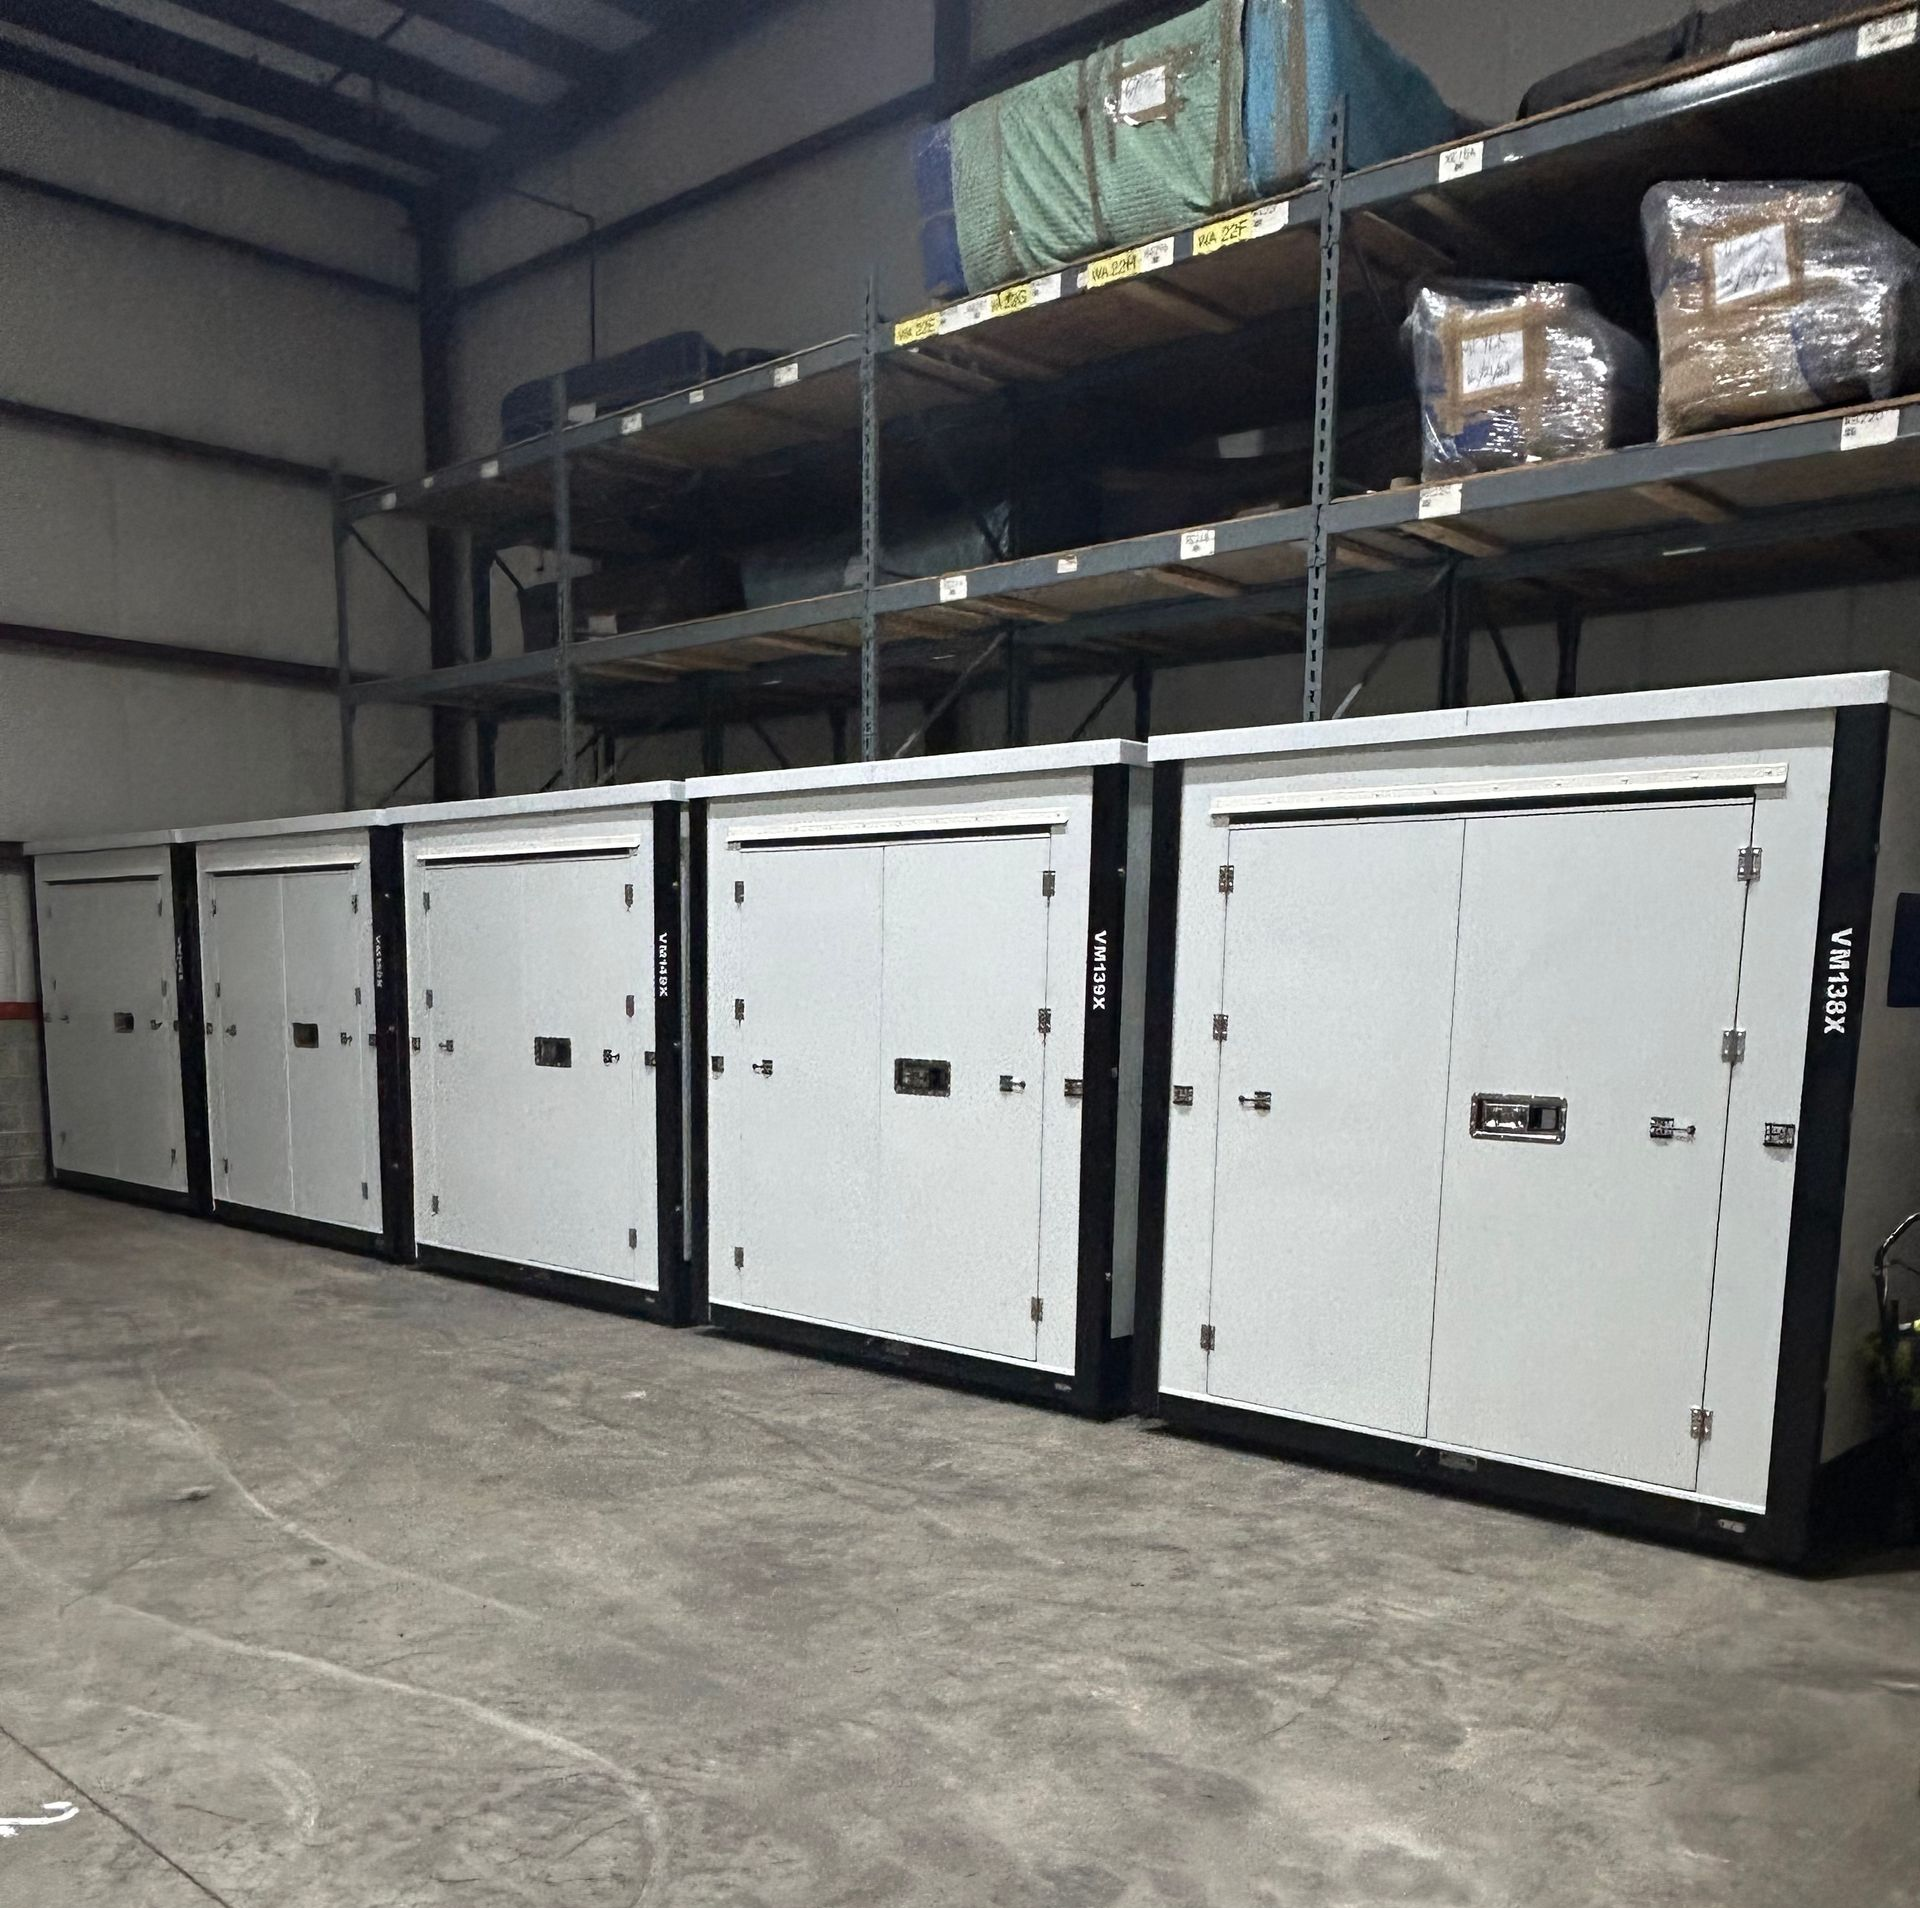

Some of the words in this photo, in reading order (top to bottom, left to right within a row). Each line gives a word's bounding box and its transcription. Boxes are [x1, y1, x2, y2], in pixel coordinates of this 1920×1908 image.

[1091, 267, 1109, 281] WA
[1093, 929, 1107, 1010] VM139X
[1824, 927, 1853, 1034] VM138X
